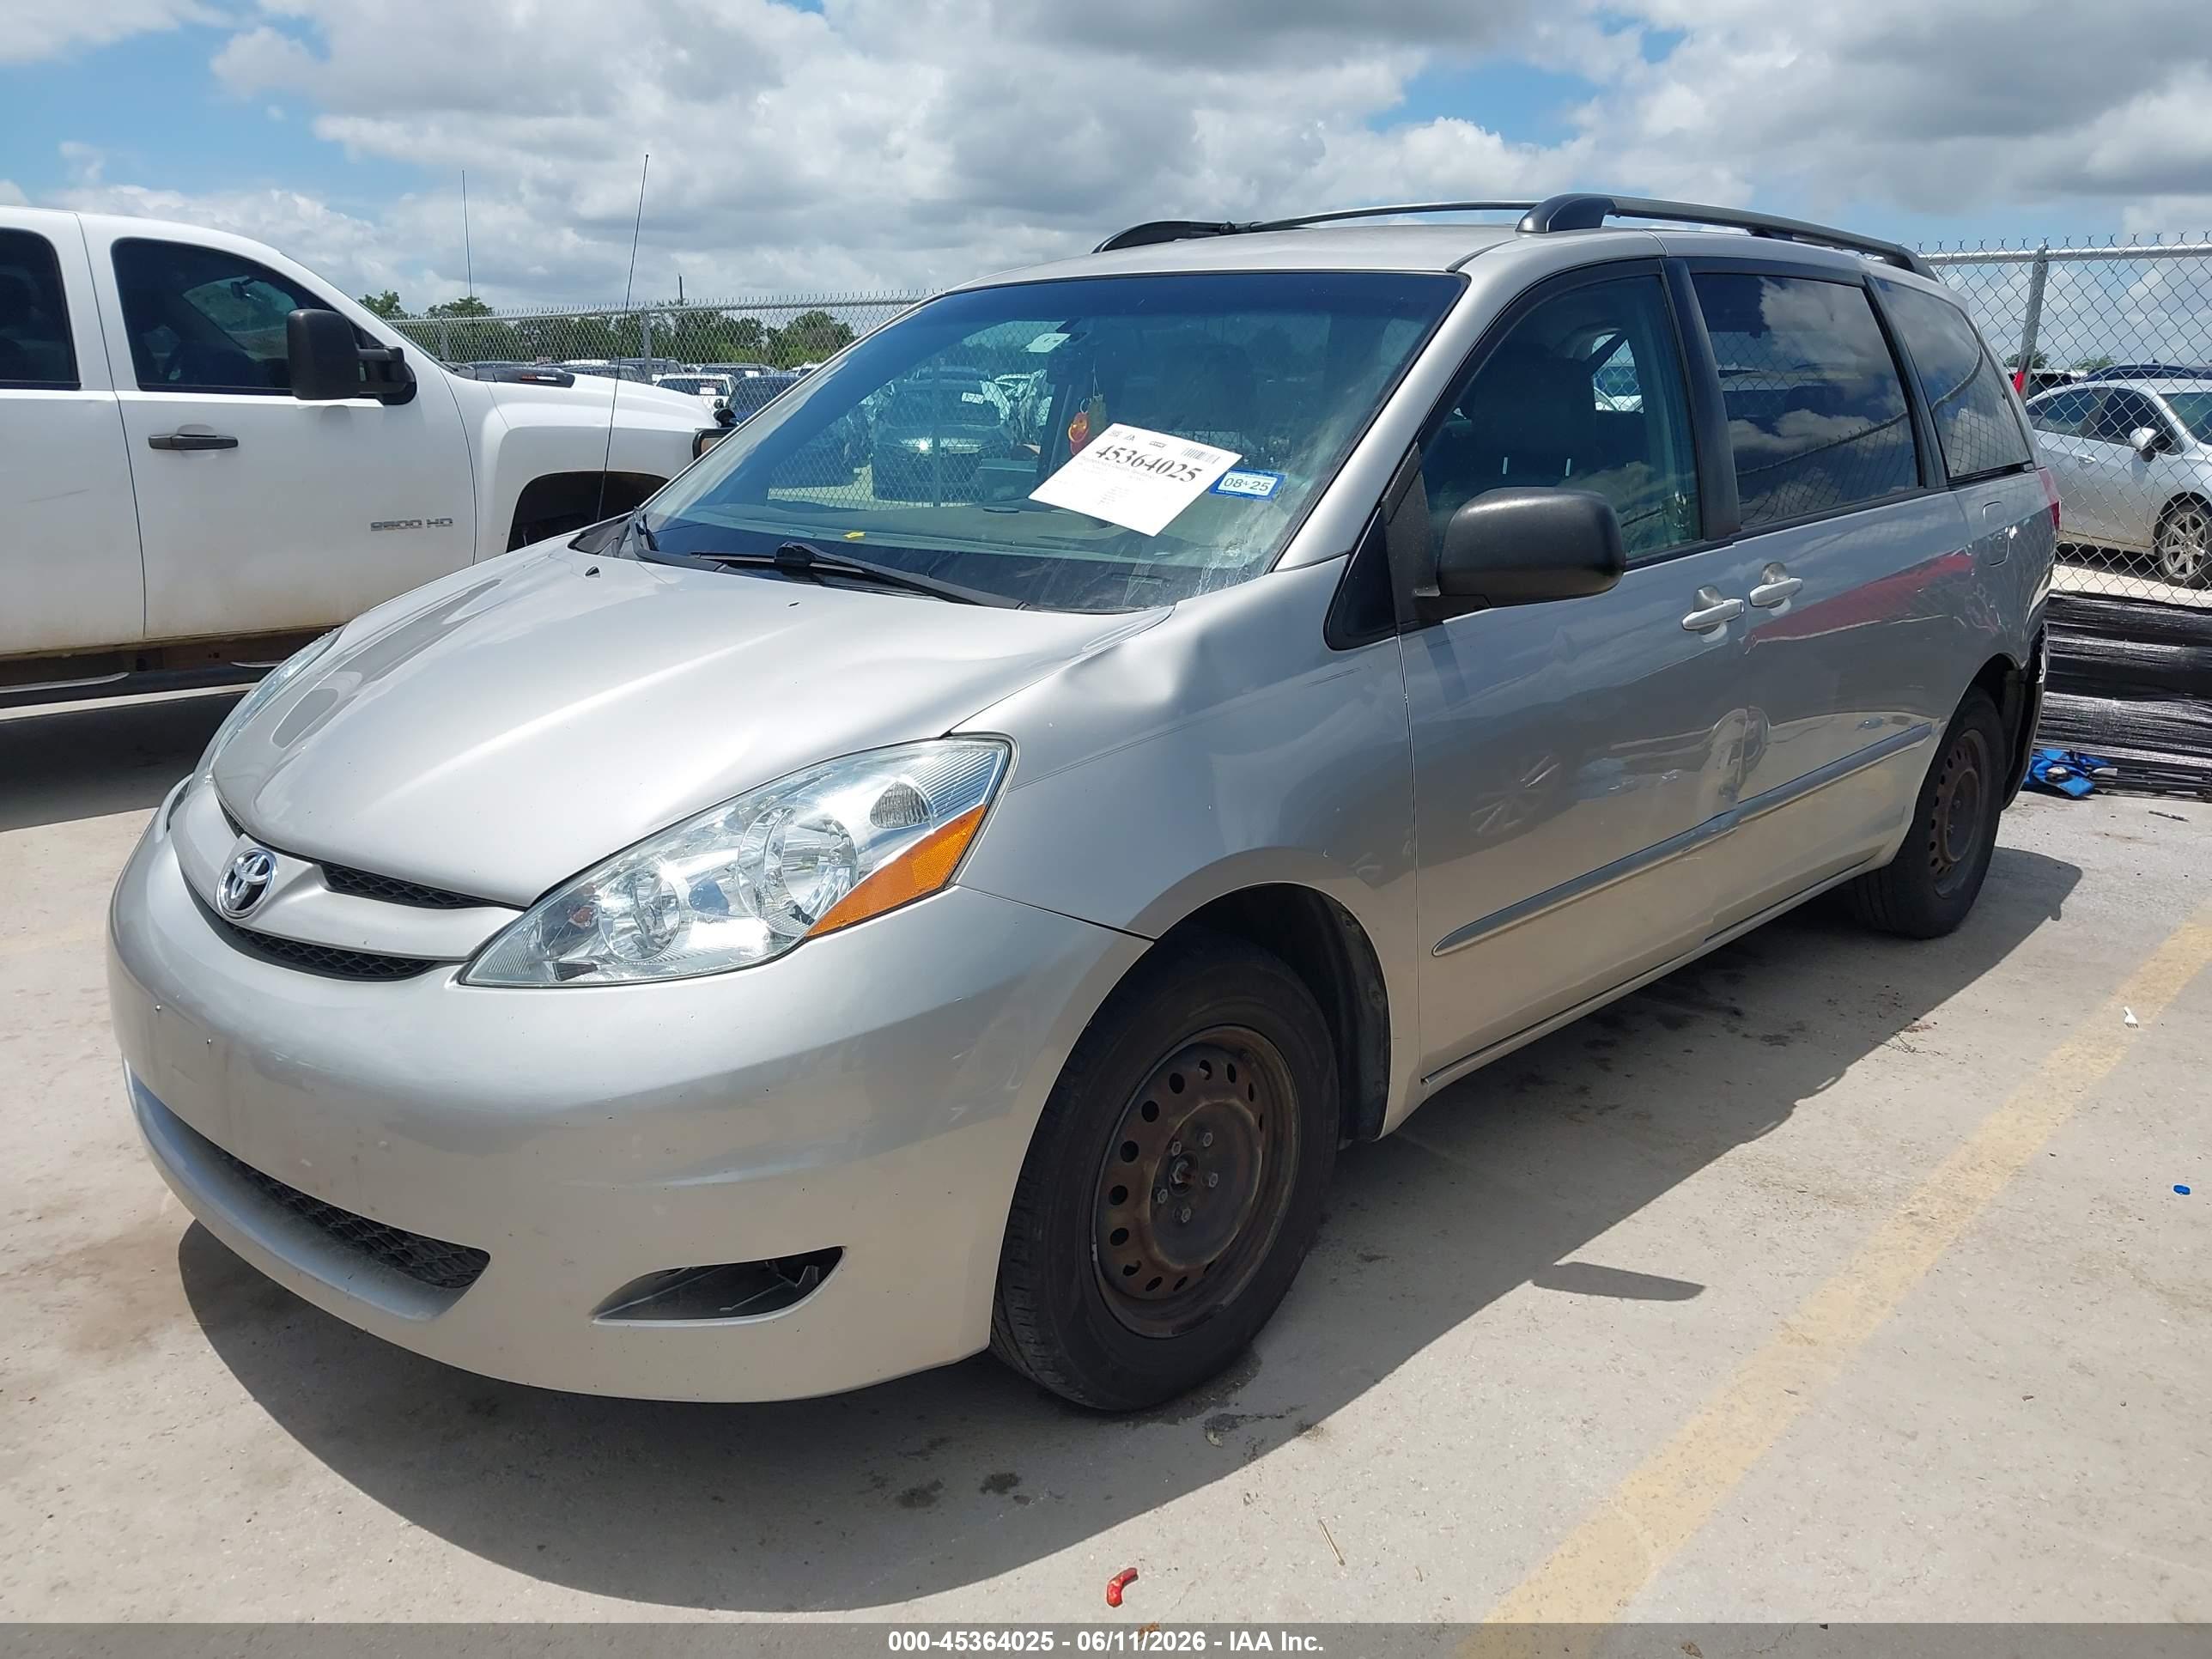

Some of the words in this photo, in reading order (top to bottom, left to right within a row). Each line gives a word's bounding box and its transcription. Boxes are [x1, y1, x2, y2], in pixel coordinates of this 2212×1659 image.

[1096, 445, 1202, 483] 45364025
[1224, 477, 1243, 489] 08
[1249, 481, 1271, 492] 25
[426, 518, 453, 528] HD
